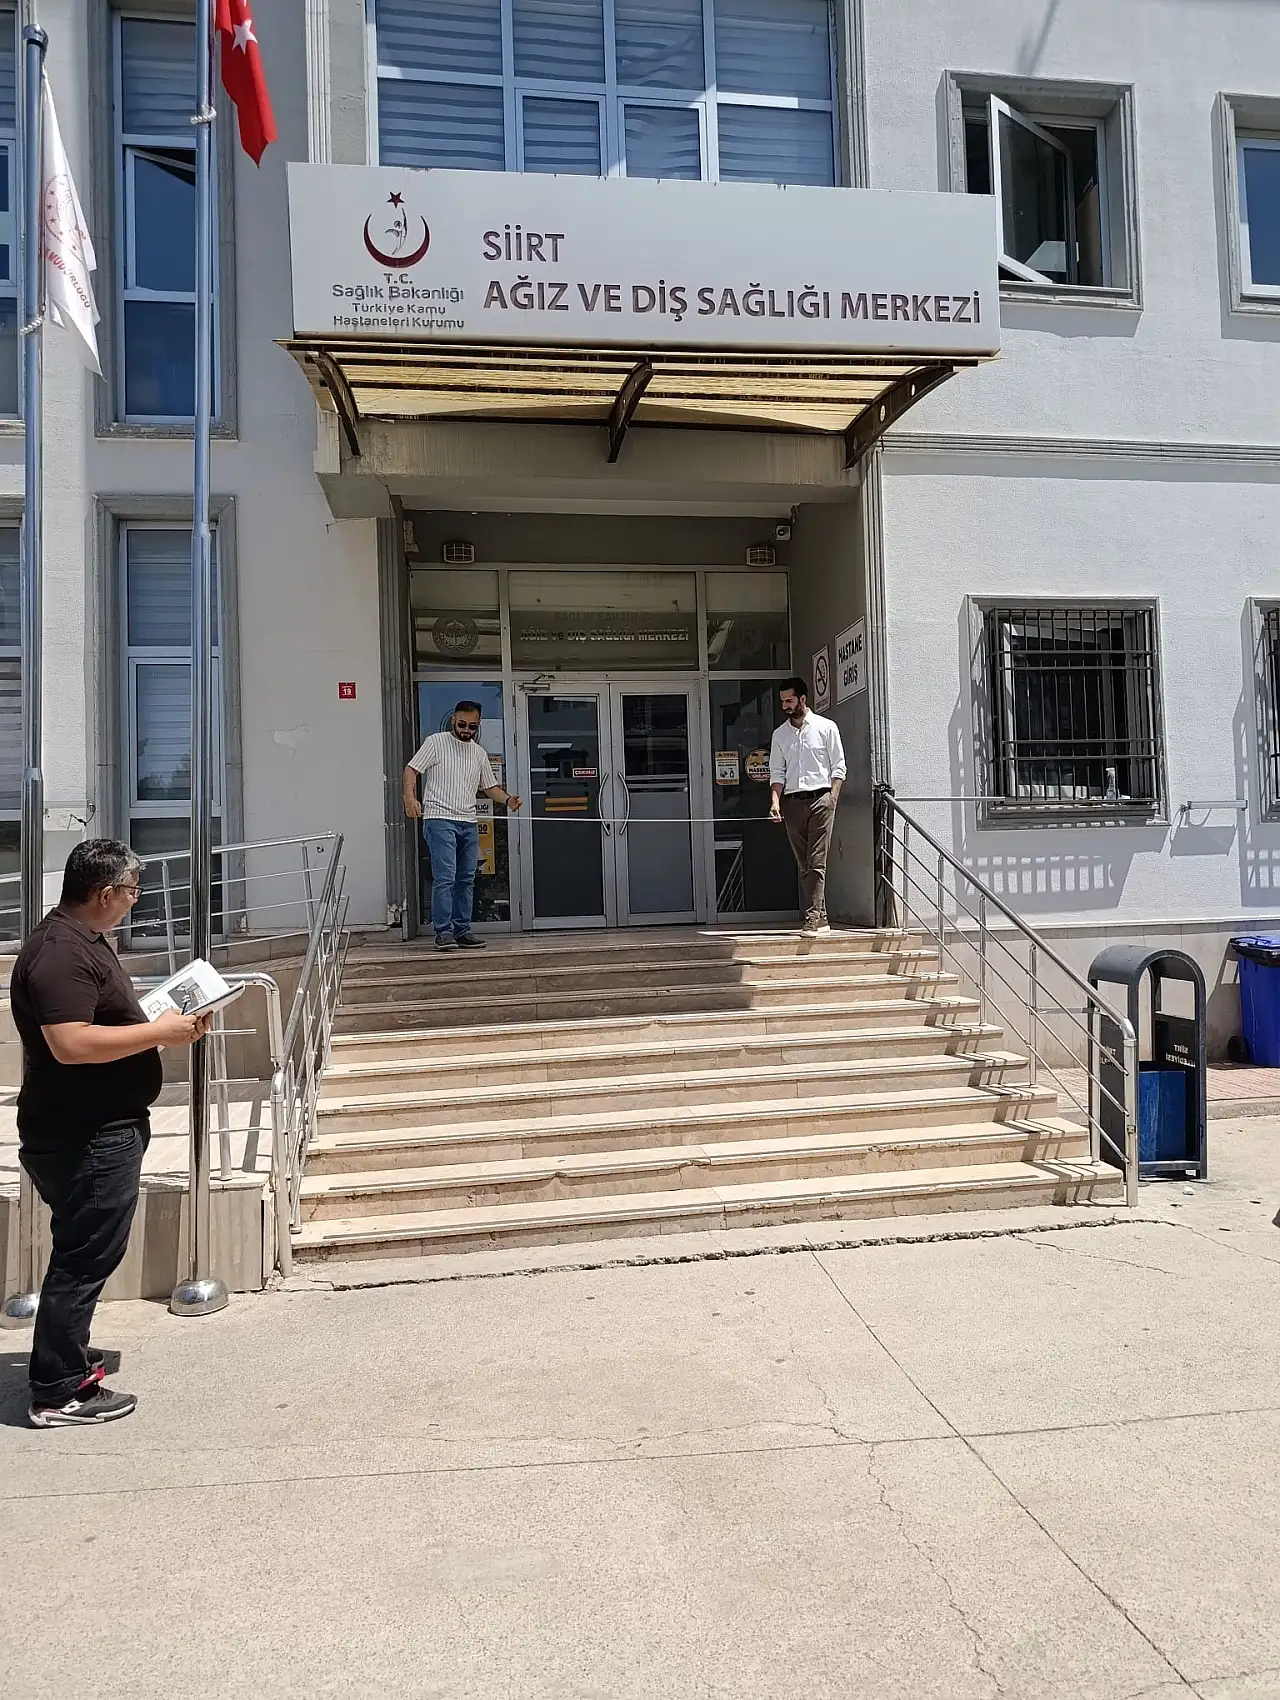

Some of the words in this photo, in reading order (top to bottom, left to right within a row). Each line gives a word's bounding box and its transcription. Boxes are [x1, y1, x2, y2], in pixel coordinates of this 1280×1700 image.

[483, 224, 565, 262] SİİRT
[383, 273, 413, 285] T.C.
[332, 284, 384, 302] Sağlık
[388, 286, 464, 303] Bakanlığı
[483, 275, 569, 312] AĞIZ
[577, 284, 622, 313] VE
[632, 280, 687, 322] DİŞ
[697, 283, 830, 319] SAĞLIĞI
[841, 291, 980, 324] MERKEZİ
[352, 302, 404, 316] Türkiye
[407, 304, 446, 315] Kamu
[333, 315, 410, 328] Hastaneleri
[412, 318, 465, 329] Kurumu
[838, 634, 862, 665] HASTANE
[843, 662, 858, 687] GİRİŞ
